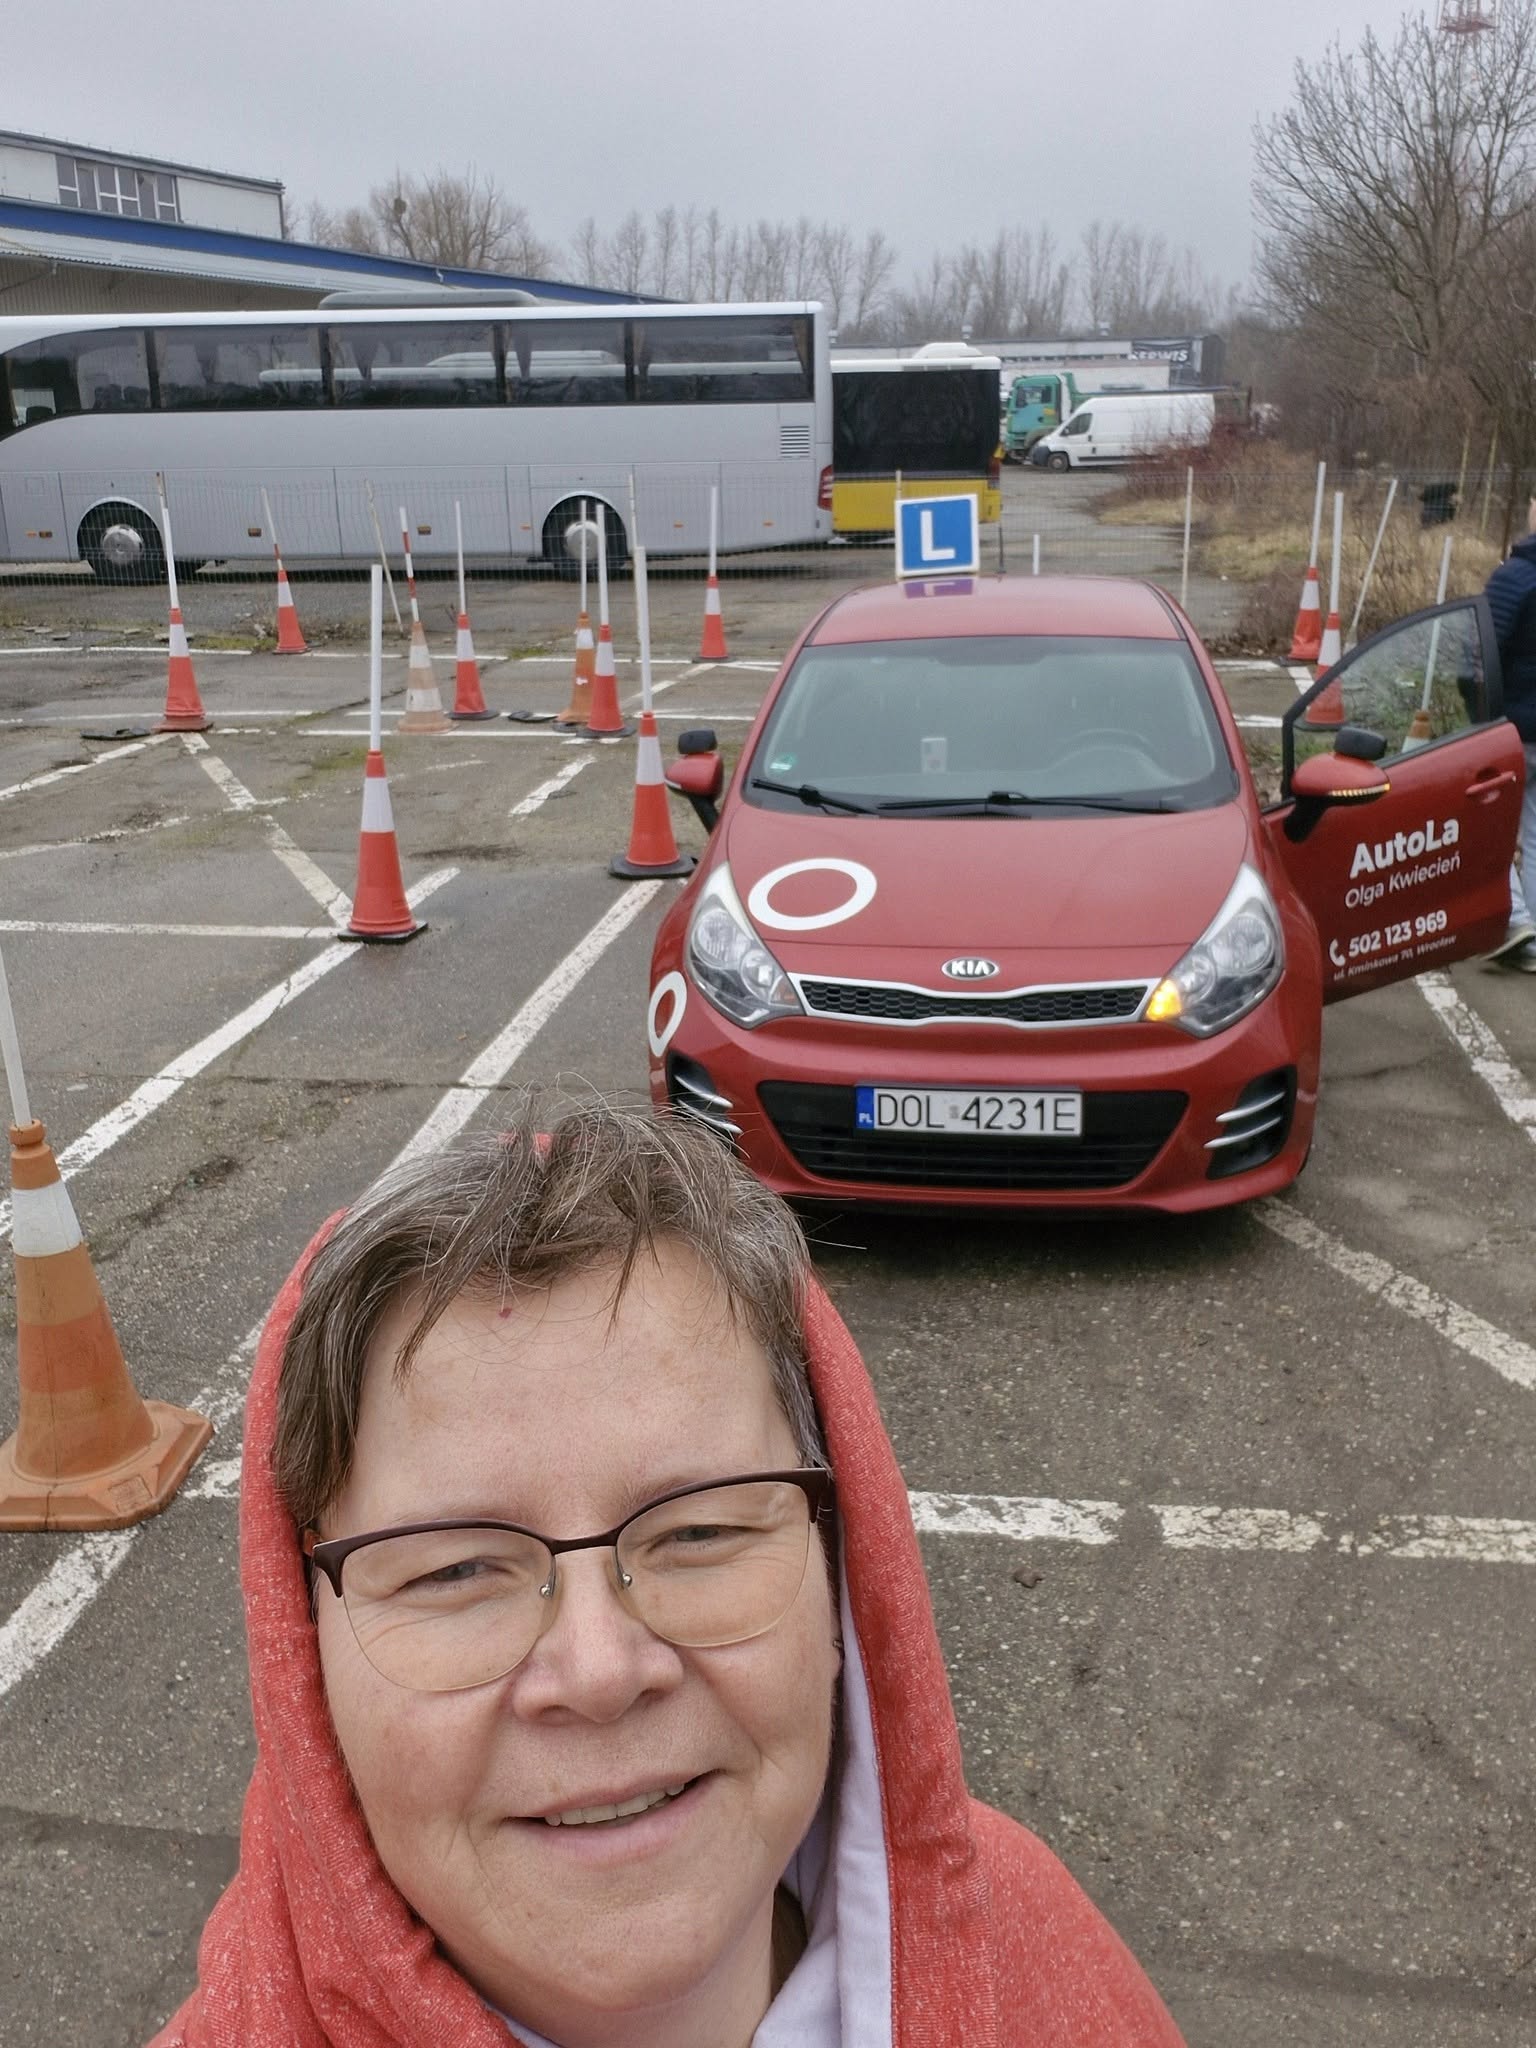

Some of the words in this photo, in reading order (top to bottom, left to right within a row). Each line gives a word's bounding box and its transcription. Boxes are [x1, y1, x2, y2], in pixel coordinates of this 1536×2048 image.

[920, 510, 956, 562] L
[1349, 818, 1459, 879] AutoLa
[1345, 882, 1385, 908] Olga
[1388, 850, 1460, 893] Kwiecień
[1348, 930, 1381, 957] 502
[1384, 921, 1412, 946] 123
[1415, 909, 1447, 937] 969
[951, 959, 990, 975] KIA
[858, 1112, 873, 1123] PL
[877, 1093, 945, 1128] DOL
[961, 1096, 1075, 1132] 4231E
